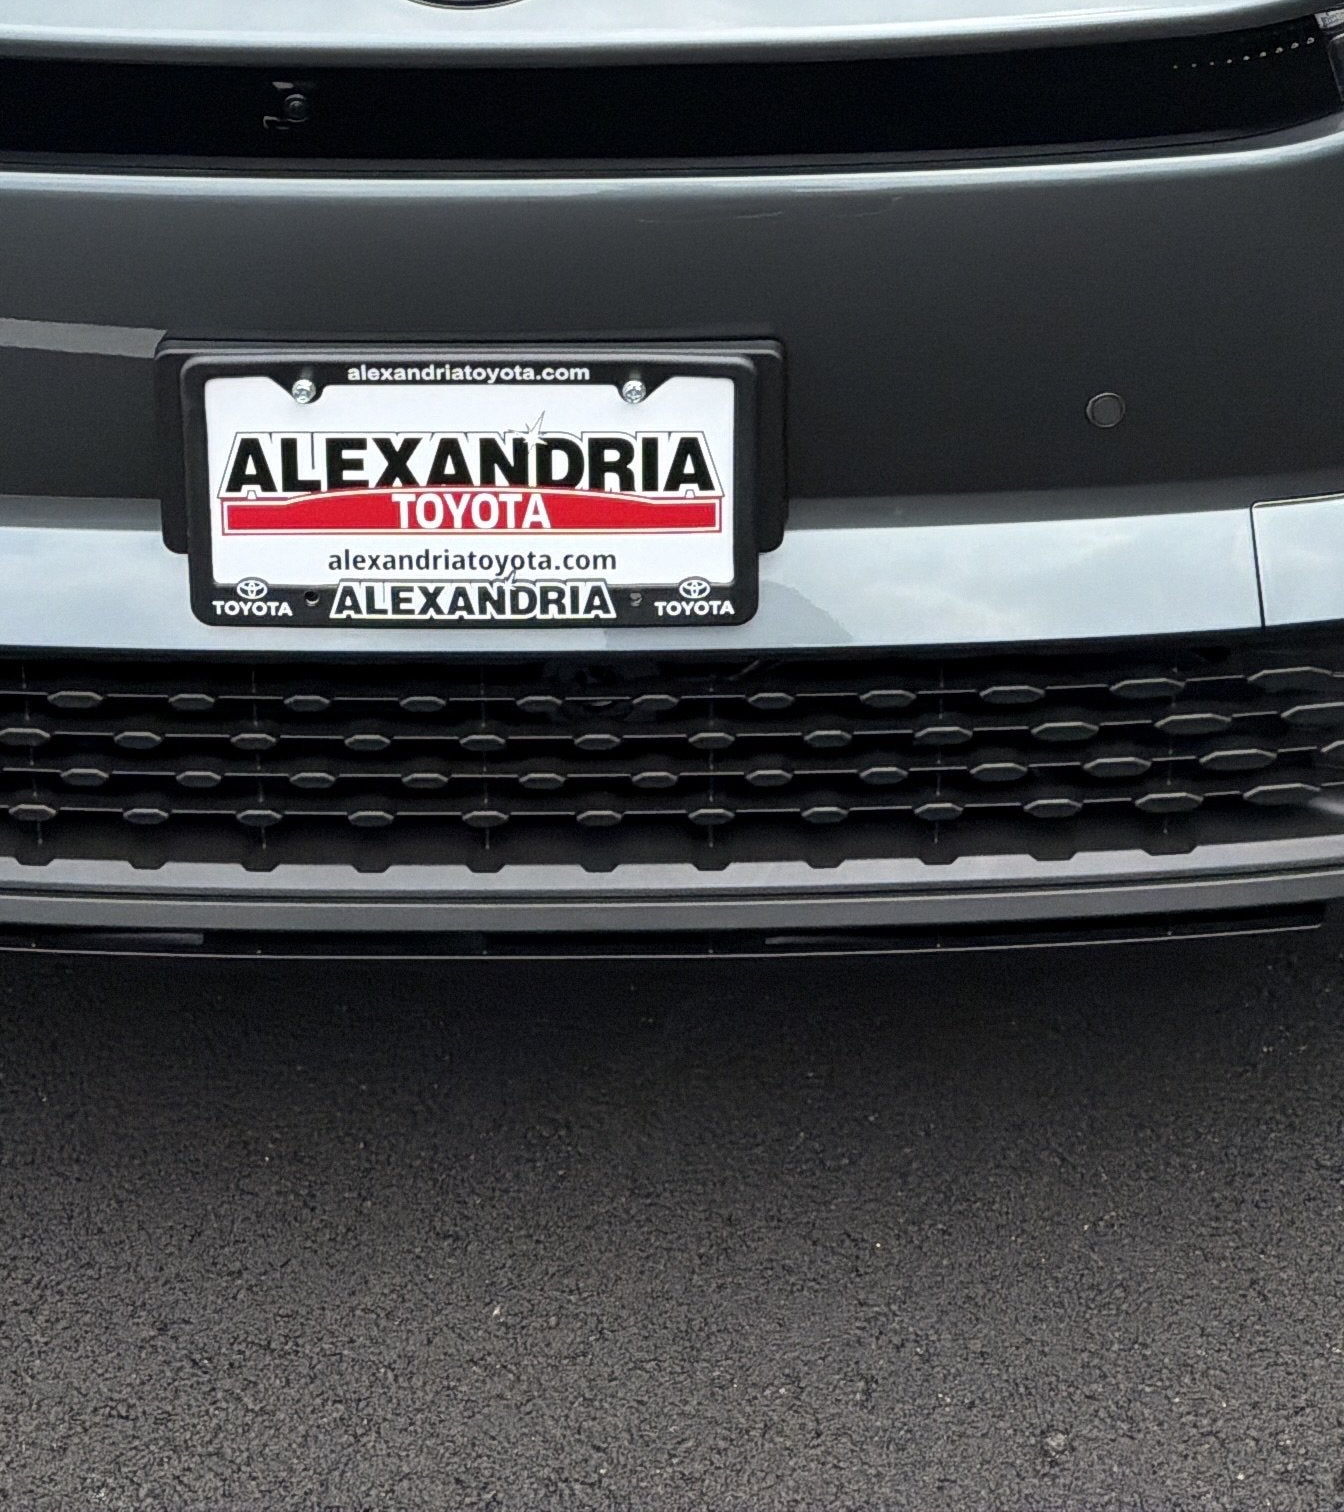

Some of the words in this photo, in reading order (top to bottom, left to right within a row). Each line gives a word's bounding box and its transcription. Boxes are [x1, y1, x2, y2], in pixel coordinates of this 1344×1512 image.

[347, 364, 591, 385] alexandriatoyota.com
[224, 436, 717, 493] ALEXANDRIA
[391, 492, 552, 530] TOYOTA
[327, 547, 617, 578] alexandriatoyota.com
[212, 599, 294, 617] TOYOTA
[330, 577, 617, 620] ALEXANDRIA
[654, 599, 736, 617] TOYOTA
